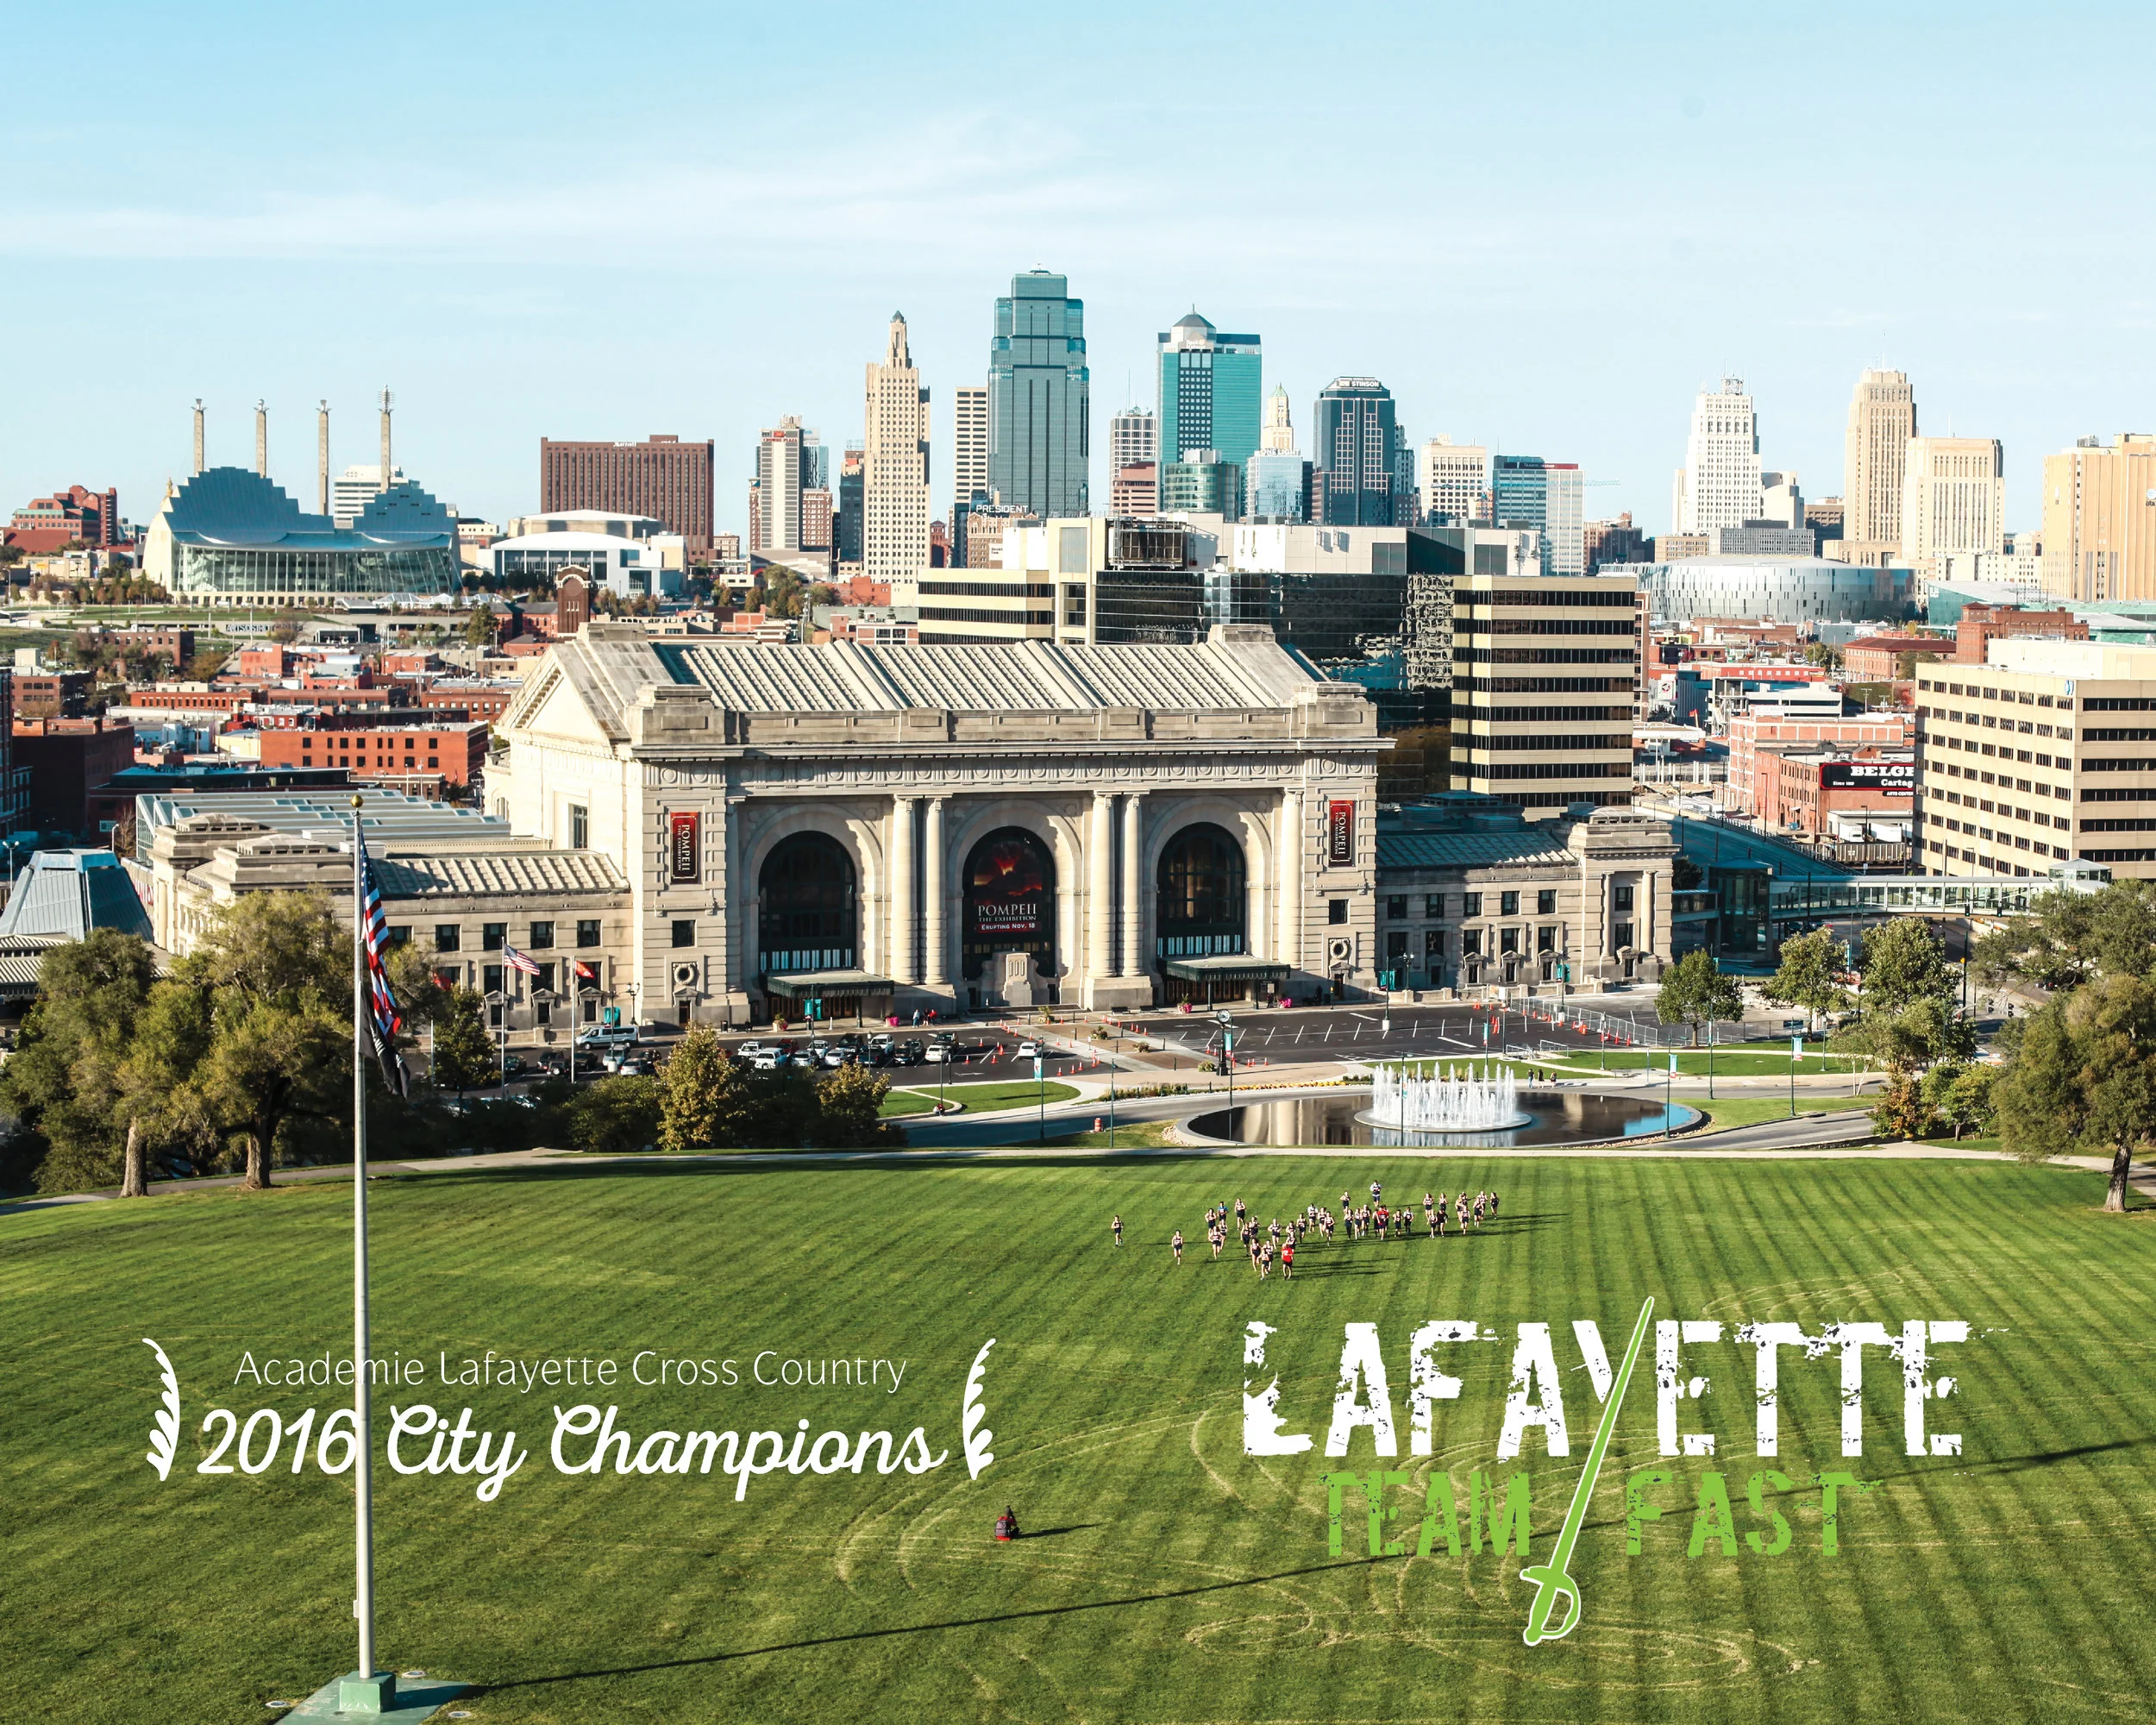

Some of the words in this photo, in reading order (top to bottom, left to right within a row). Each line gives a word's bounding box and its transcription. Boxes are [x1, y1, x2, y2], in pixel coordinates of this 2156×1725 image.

[976, 505, 1029, 513] PRESIDENT
[681, 825, 690, 871] POMPEII
[978, 903, 1037, 917] POMPEII
